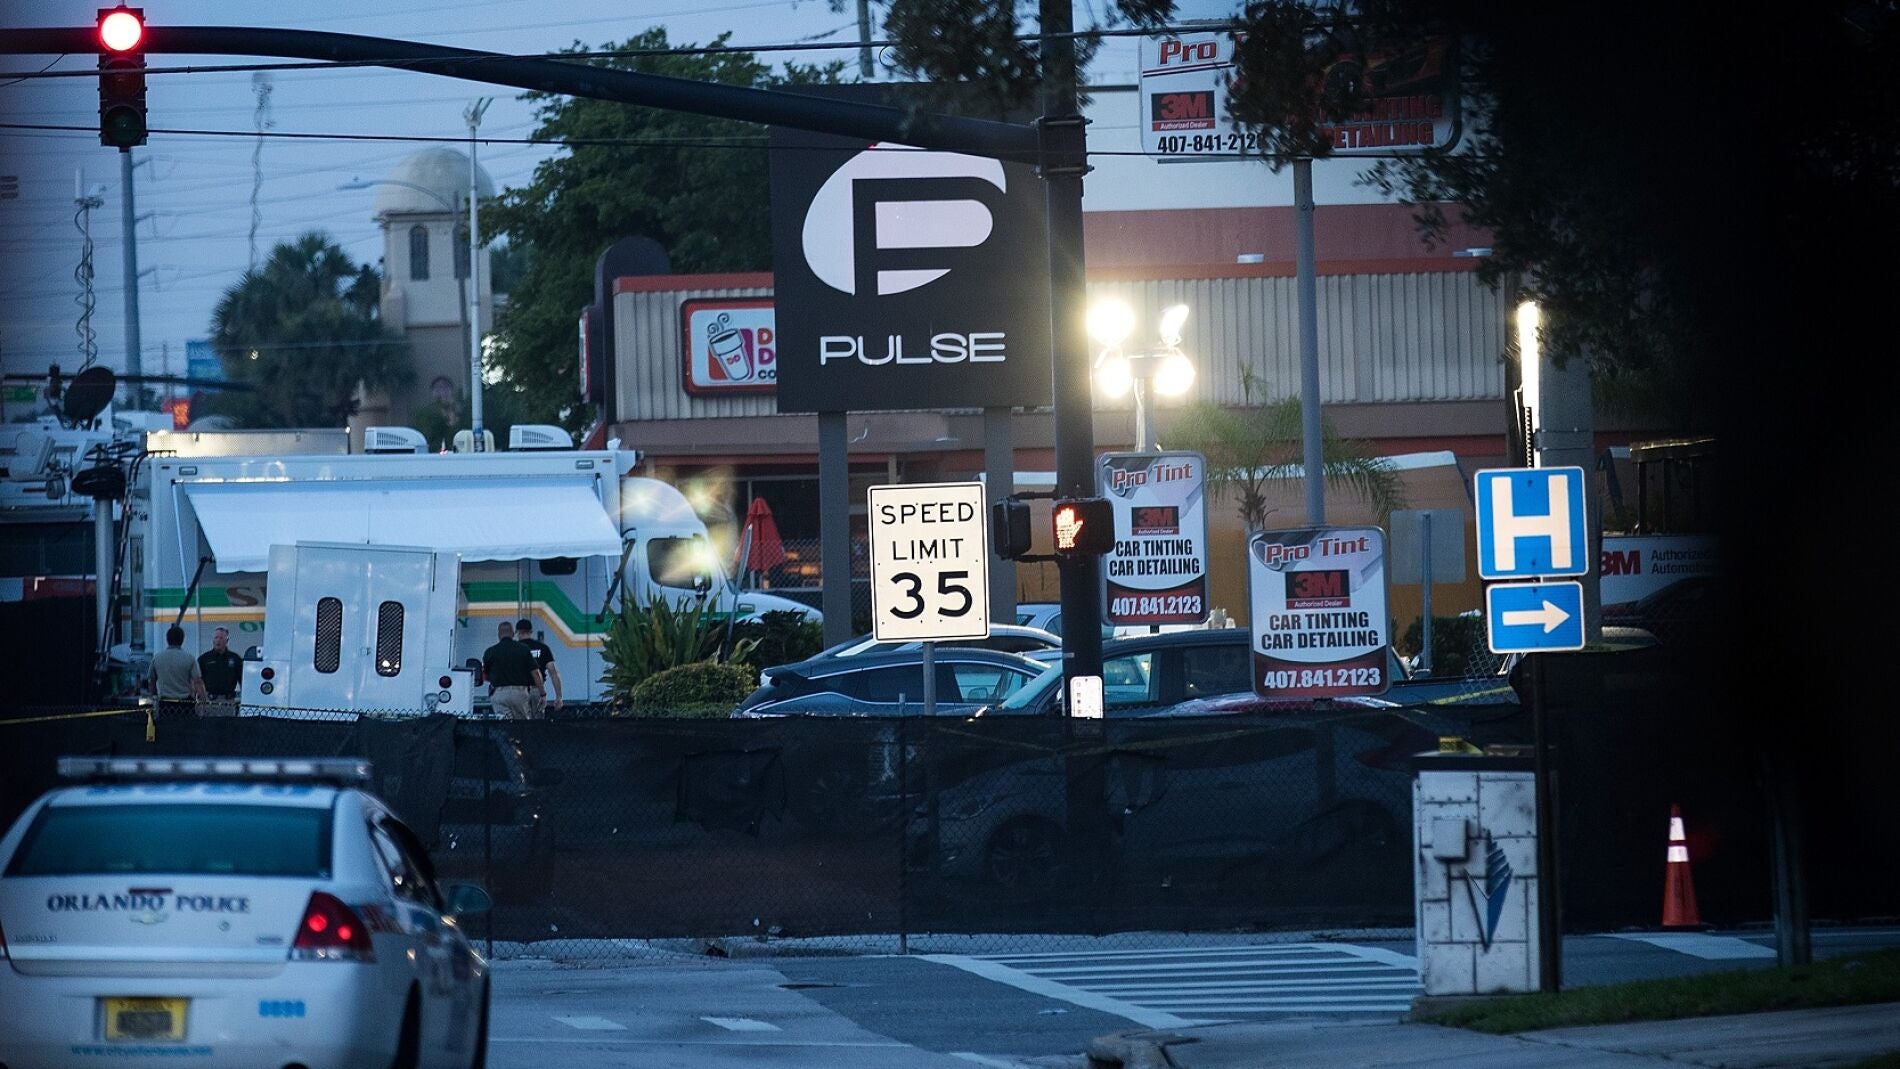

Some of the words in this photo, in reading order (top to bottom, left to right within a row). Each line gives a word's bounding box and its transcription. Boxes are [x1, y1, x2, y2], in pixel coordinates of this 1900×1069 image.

[1158, 40, 1217, 65] Pro
[1160, 93, 1207, 119] 3M
[1160, 121, 1189, 130] Authorized
[1190, 120, 1208, 129] Dealer
[820, 332, 1006, 366] PULSE
[1111, 468, 1148, 490] Pro
[1154, 463, 1193, 483] Tint
[881, 502, 975, 525] SPEED
[1137, 508, 1173, 527] 3M
[1491, 474, 1572, 571] H
[892, 538, 964, 560] LIMIT
[1115, 540, 1141, 557] CAR
[1143, 539, 1193, 557] TINTING
[1264, 543, 1310, 565] Pro
[1319, 536, 1370, 557] Tint
[1109, 560, 1134, 577] CAR
[1137, 558, 1201, 576] DETAILING
[889, 570, 973, 620] 35
[1295, 571, 1342, 598] 3M
[1111, 595, 1202, 616] 407.841.2123
[1295, 600, 1324, 608] Authorized
[1269, 613, 1301, 631] CAR
[1305, 612, 1369, 629] TINTING
[1261, 633, 1294, 650] CAR
[1298, 630, 1379, 649] DETAILING
[1264, 668, 1381, 689] 407.841.2123
[48, 894, 165, 913] ORLANDO
[176, 896, 250, 914] POLICE
